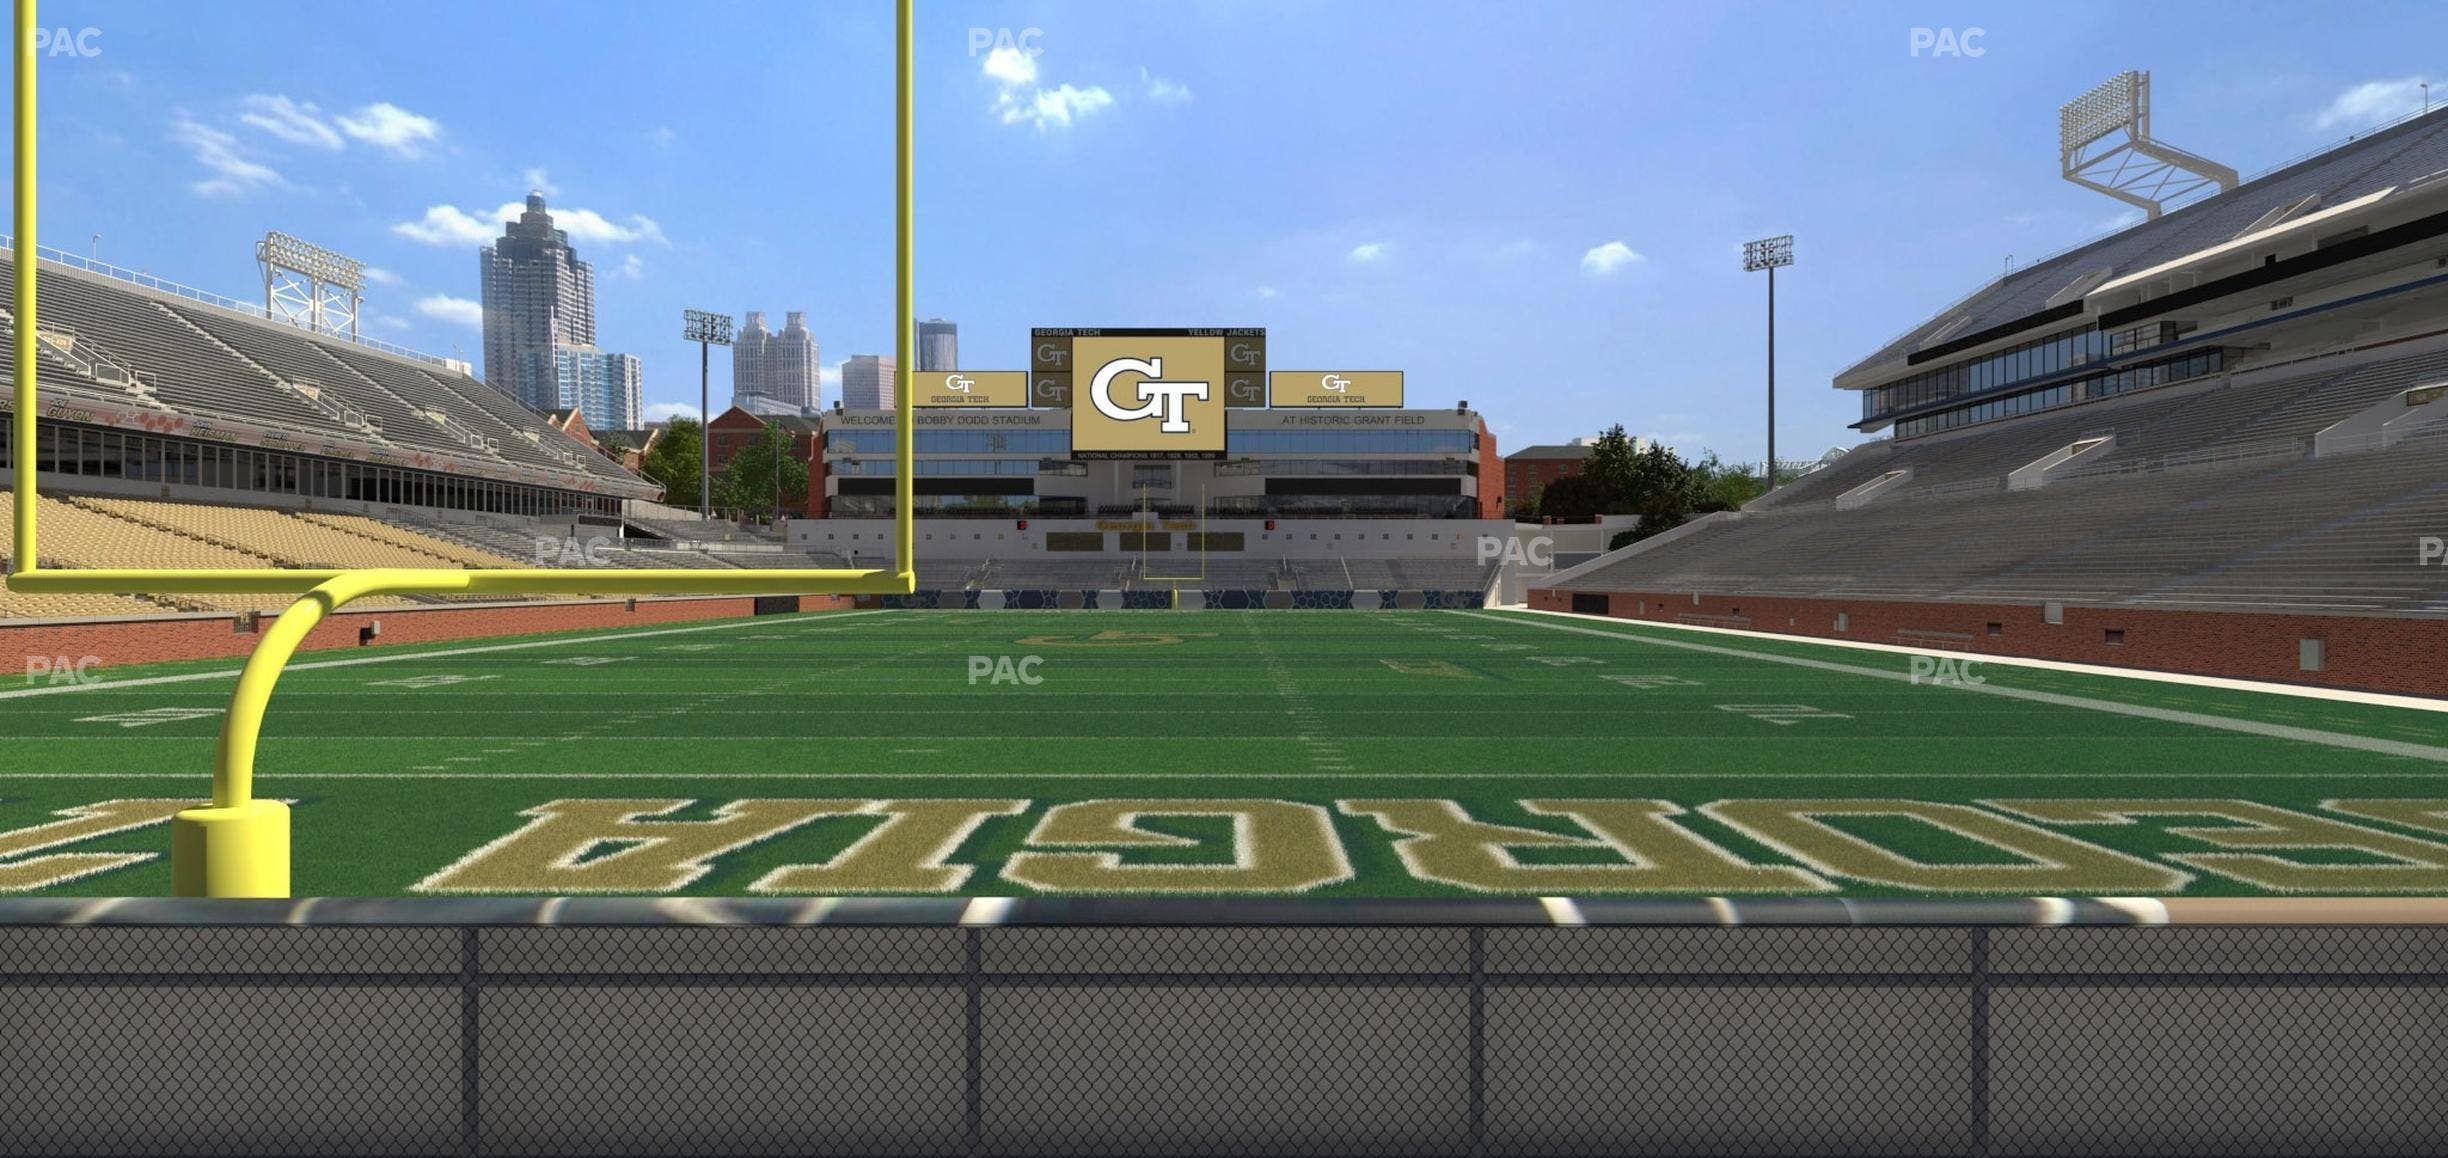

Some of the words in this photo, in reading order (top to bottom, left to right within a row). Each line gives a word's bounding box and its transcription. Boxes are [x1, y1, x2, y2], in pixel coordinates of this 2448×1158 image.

[1034, 328, 1073, 336] GEORGIA
[1078, 328, 1100, 336] TECH
[1188, 328, 1223, 336] YELLOW
[1226, 328, 1265, 336] JACKETS
[945, 374, 975, 393] GT
[1321, 374, 1351, 393] GT
[930, 395, 965, 403] GEORGIA
[967, 395, 989, 403] TECH
[1090, 356, 1209, 433] GT
[1307, 395, 1341, 403] GEORGIA
[1344, 395, 1365, 403] TECH
[840, 415, 896, 425] WELCOME
[917, 415, 953, 425] BOBBY
[957, 415, 989, 425] DODD
[992, 415, 1041, 425] STADIUM
[1281, 415, 1296, 425] AT
[1300, 415, 1350, 425] HISTORIC
[1354, 415, 1391, 425] GRANT
[1394, 415, 1425, 425] FIELD
